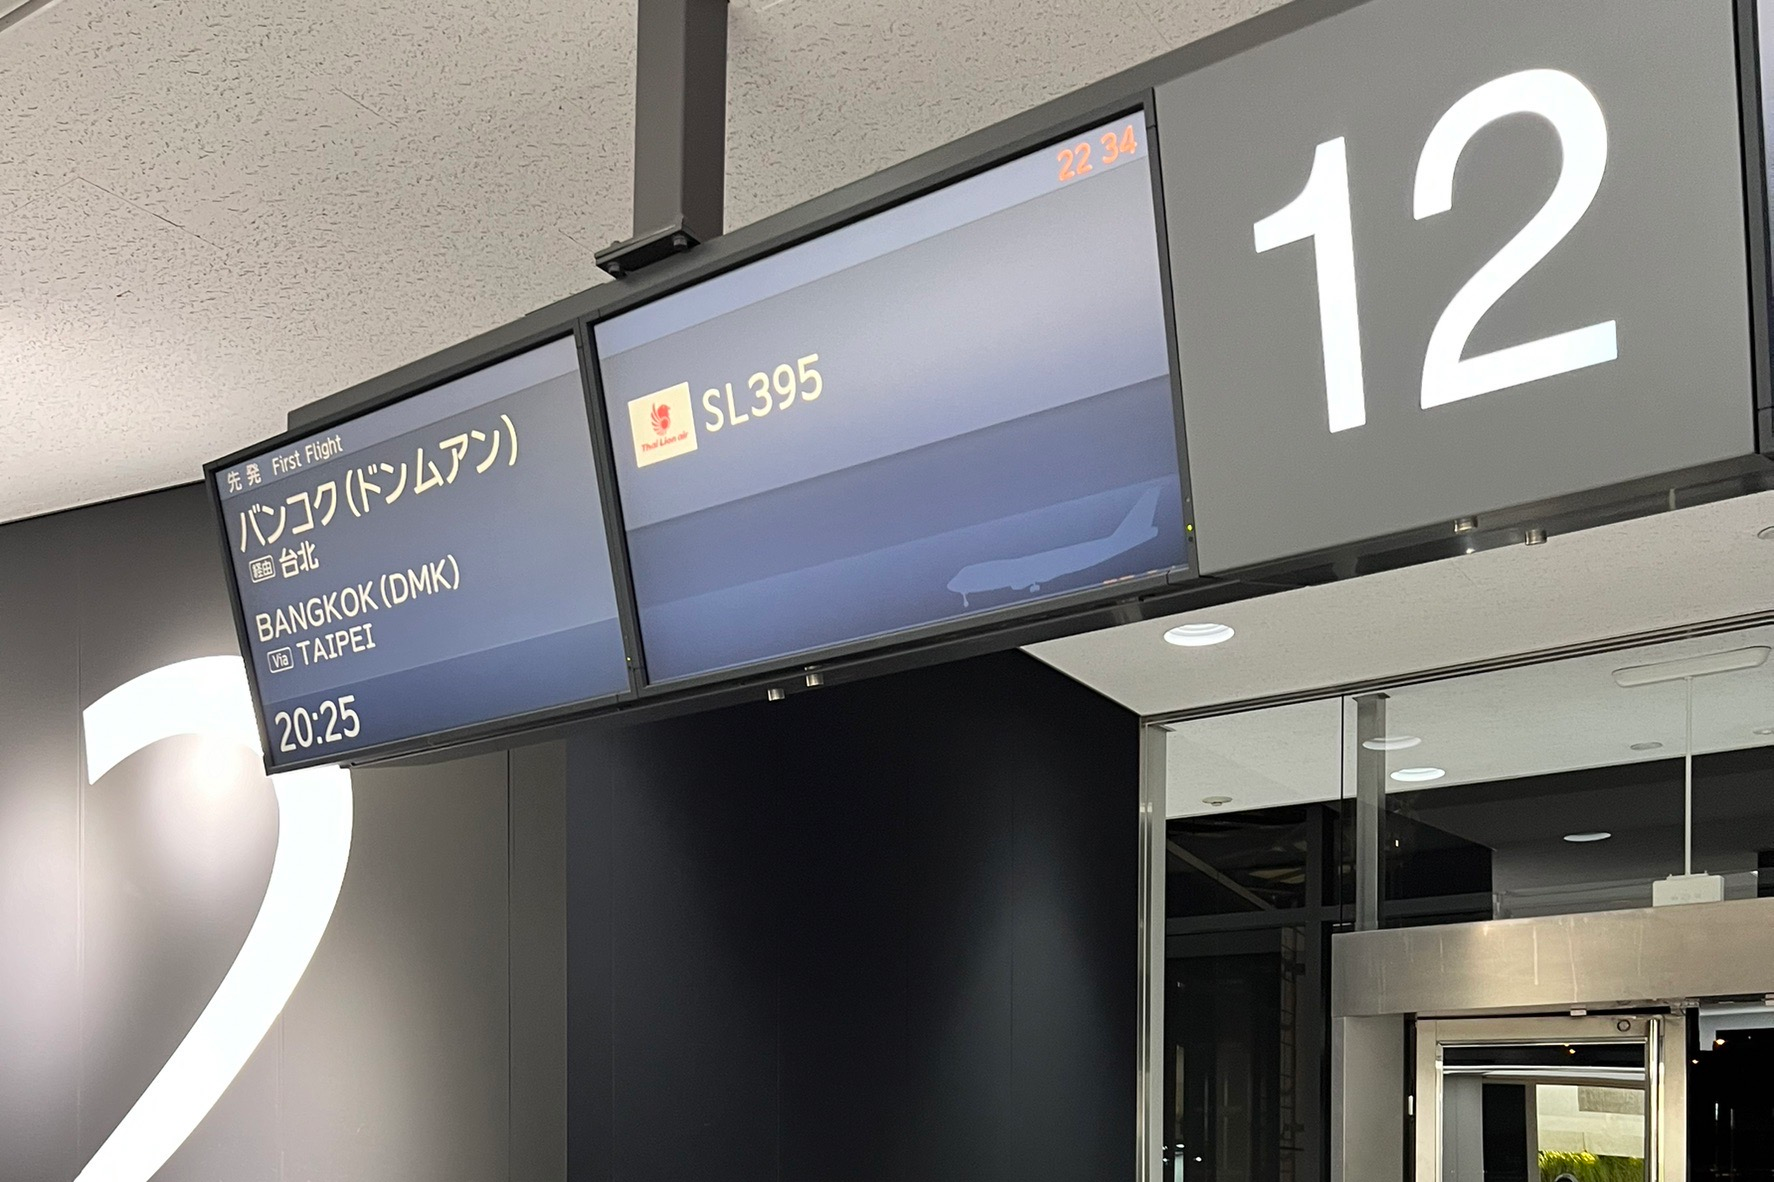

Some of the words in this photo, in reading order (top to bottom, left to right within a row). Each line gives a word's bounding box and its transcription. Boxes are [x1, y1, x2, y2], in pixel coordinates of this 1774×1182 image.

[1057, 142, 1093, 181] 22
[1101, 124, 1138, 165] 34
[1253, 68, 1618, 433] 12
[702, 353, 823, 432] SL395
[272, 450, 302, 475] First
[305, 434, 343, 463] Flight
[641, 438, 659, 452] Thai
[659, 436, 677, 447] Lion
[677, 430, 689, 441] air
[239, 414, 518, 552] バンコク(ドンムアン)
[251, 560, 273, 579] 経由
[279, 540, 319, 578] 台北
[255, 581, 379, 642] BANGKOK
[380, 554, 460, 608] (DMK)
[271, 652, 289, 668] Via
[296, 623, 376, 665] TAIPEI
[274, 695, 361, 752] 20:25
